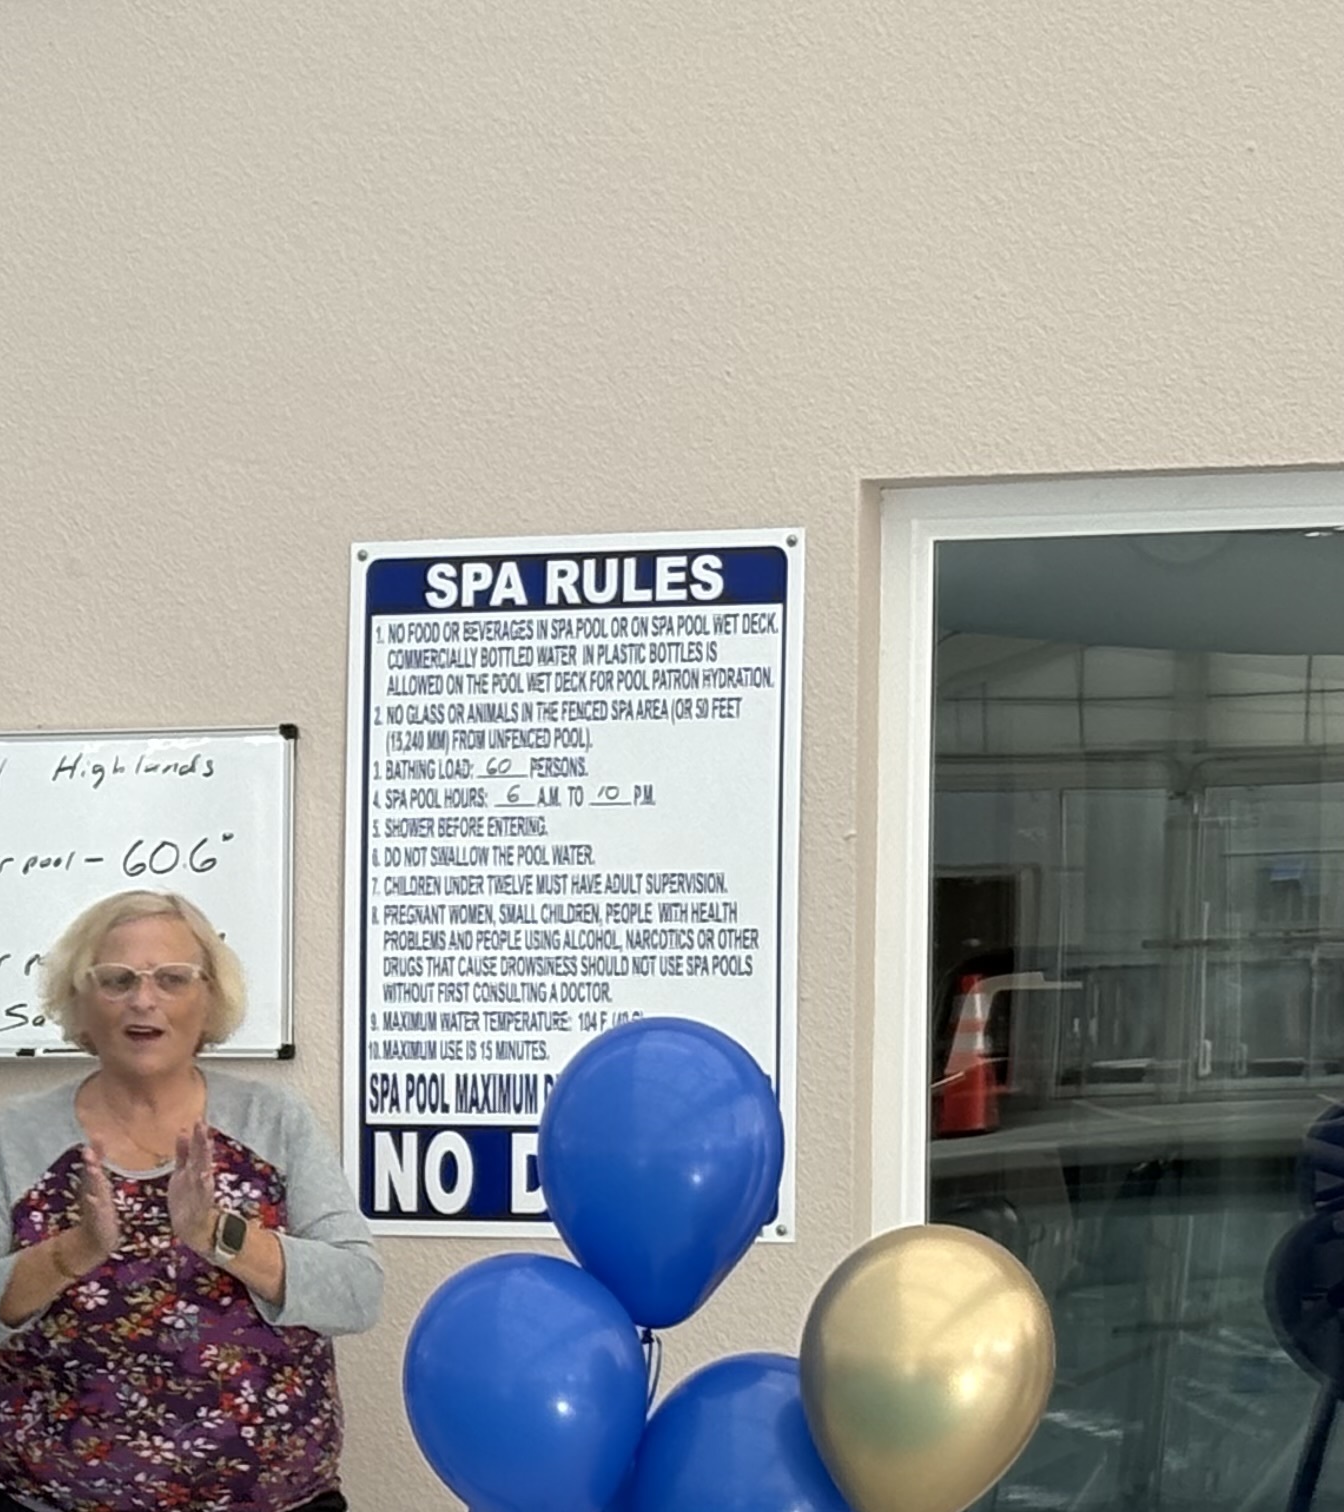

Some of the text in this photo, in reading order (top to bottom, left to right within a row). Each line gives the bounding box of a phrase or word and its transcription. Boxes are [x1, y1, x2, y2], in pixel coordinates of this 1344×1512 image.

[425, 554, 724, 609] SPA RULES
[387, 623, 405, 644] NO
[407, 622, 440, 644] FOOD
[442, 621, 460, 643] OR
[462, 620, 534, 642] BEVERAGES
[536, 619, 548, 640] IN
[550, 618, 573, 640] SPA
[575, 618, 608, 640] POOL
[610, 617, 628, 639] OR
[630, 616, 648, 638] ON
[651, 616, 674, 638] SPA
[676, 615, 709, 637] POOL
[712, 614, 738, 636] WET
[387, 641, 718, 670] COMMERCIALLY BOTTLED WATER IN PLASTIC BOTTLES IS
[386, 704, 404, 723] NO
[406, 703, 445, 723] GLASS
[447, 703, 464, 722] OR
[467, 702, 518, 722] ANIMALS
[521, 702, 533, 721] IN
[536, 701, 558, 721] THE
[561, 700, 608, 721] FENCED
[611, 700, 633, 720] SPA
[635, 699, 668, 720] AREA
[695, 698, 709, 719] 50
[711, 697, 743, 719] FEET
[51, 753, 214, 789] Highlands
[385, 760, 436, 780] BATHING
[385, 788, 407, 808] SPA
[409, 788, 441, 808] POOL
[384, 818, 434, 837] SHOWER
[437, 817, 484, 837] BEFORE
[22, 850, 77, 876] pool
[384, 848, 401, 867] DO
[403, 847, 427, 867] NOT
[492, 846, 514, 866] THE
[517, 846, 549, 866] POOL
[382, 984, 434, 1002] WITHOUT
[437, 983, 469, 1002] FIRST
[472, 983, 547, 1002] CONSULTING
[549, 983, 557, 1002] A
[382, 1013, 437, 1031] MAXIMUM
[440, 1012, 480, 1031] WATER
[578, 1012, 597, 1031] 104
[382, 1041, 437, 1061] MAXIMUM
[439, 1041, 463, 1060] USE
[465, 1041, 476, 1060] IS
[480, 1041, 492, 1060] 15
[369, 1073, 538, 1113] SPA POOL MAXIMUM
[374, 1131, 473, 1214] NO
